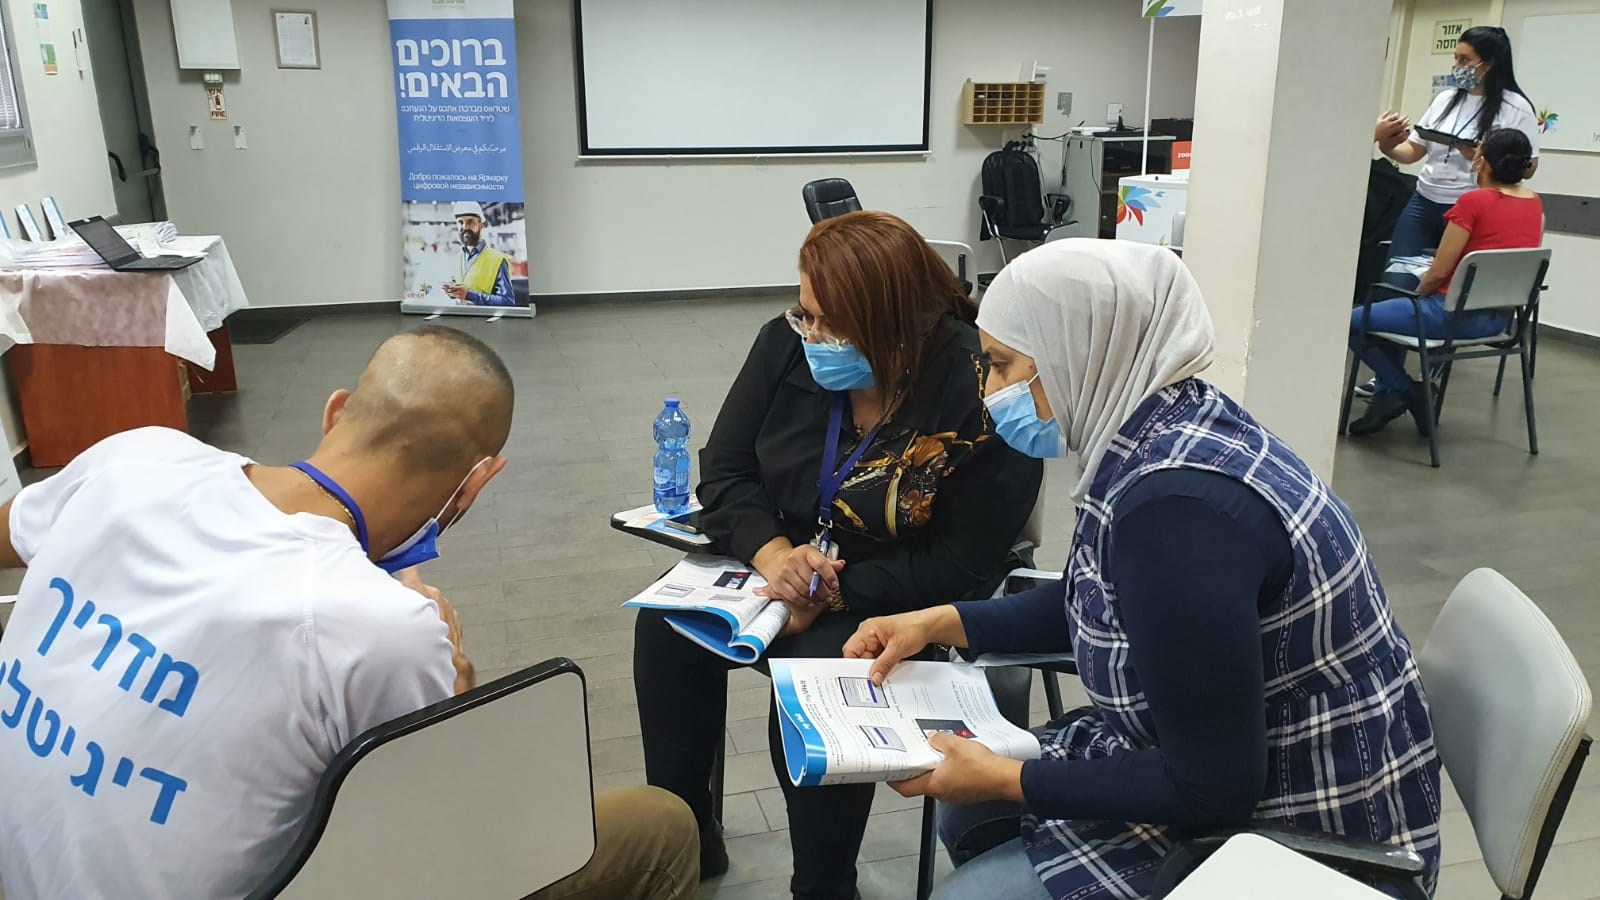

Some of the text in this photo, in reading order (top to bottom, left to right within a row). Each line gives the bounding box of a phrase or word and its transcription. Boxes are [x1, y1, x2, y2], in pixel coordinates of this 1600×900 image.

[1442, 24, 1462, 35] אזור
[1436, 39, 1457, 49] חסה
[396, 38, 506, 67] ברוכים
[399, 71, 508, 98] הבאים!
[409, 172, 432, 181] Добро
[478, 174, 509, 183] Ярмарку
[450, 183, 505, 191] независимости
[37, 577, 199, 717] מדריך
